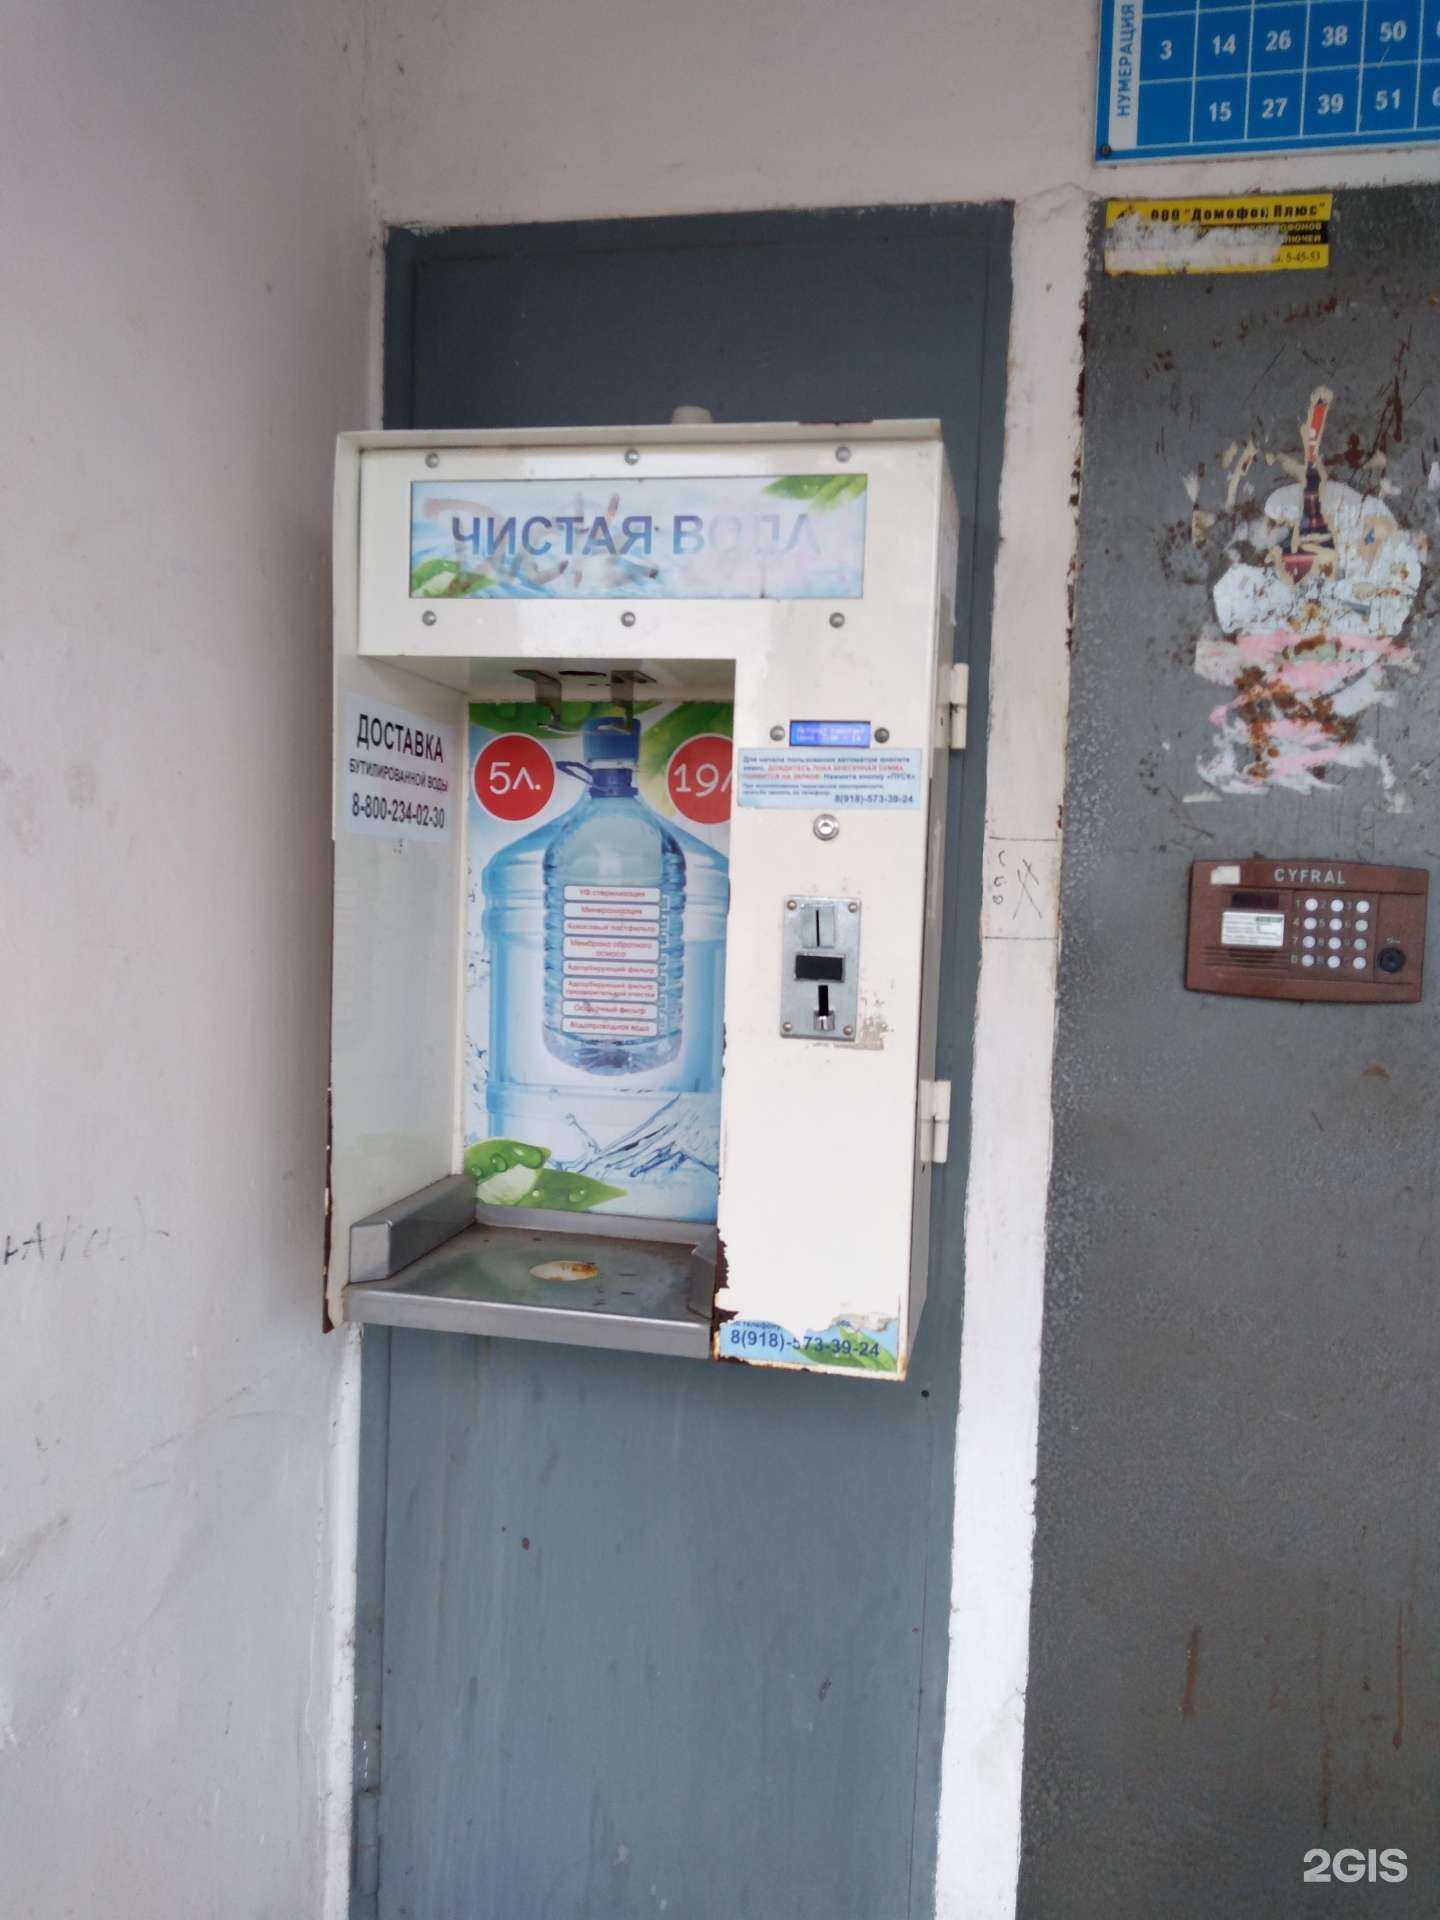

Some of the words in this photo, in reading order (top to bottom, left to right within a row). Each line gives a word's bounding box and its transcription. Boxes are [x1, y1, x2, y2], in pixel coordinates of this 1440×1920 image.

[1265, 30, 1292, 51] 26
[1321, 25, 1348, 47] 38
[1379, 20, 1407, 42] 50
[1160, 40, 1173, 60] 3
[1212, 33, 1236, 56] 14
[1117, 4, 1136, 117] НУМЕРАЦИЯ
[1262, 98, 1288, 118] 27
[1318, 93, 1344, 115] 39
[1375, 89, 1401, 111] 51
[1209, 101, 1232, 122] 15
[452, 516, 652, 556] ЧИСТАЯ
[357, 714, 444, 763] ДОСТАВКА
[352, 793, 445, 829] 8-800-234-02-30
[1274, 868, 1346, 885] CYFRAL
